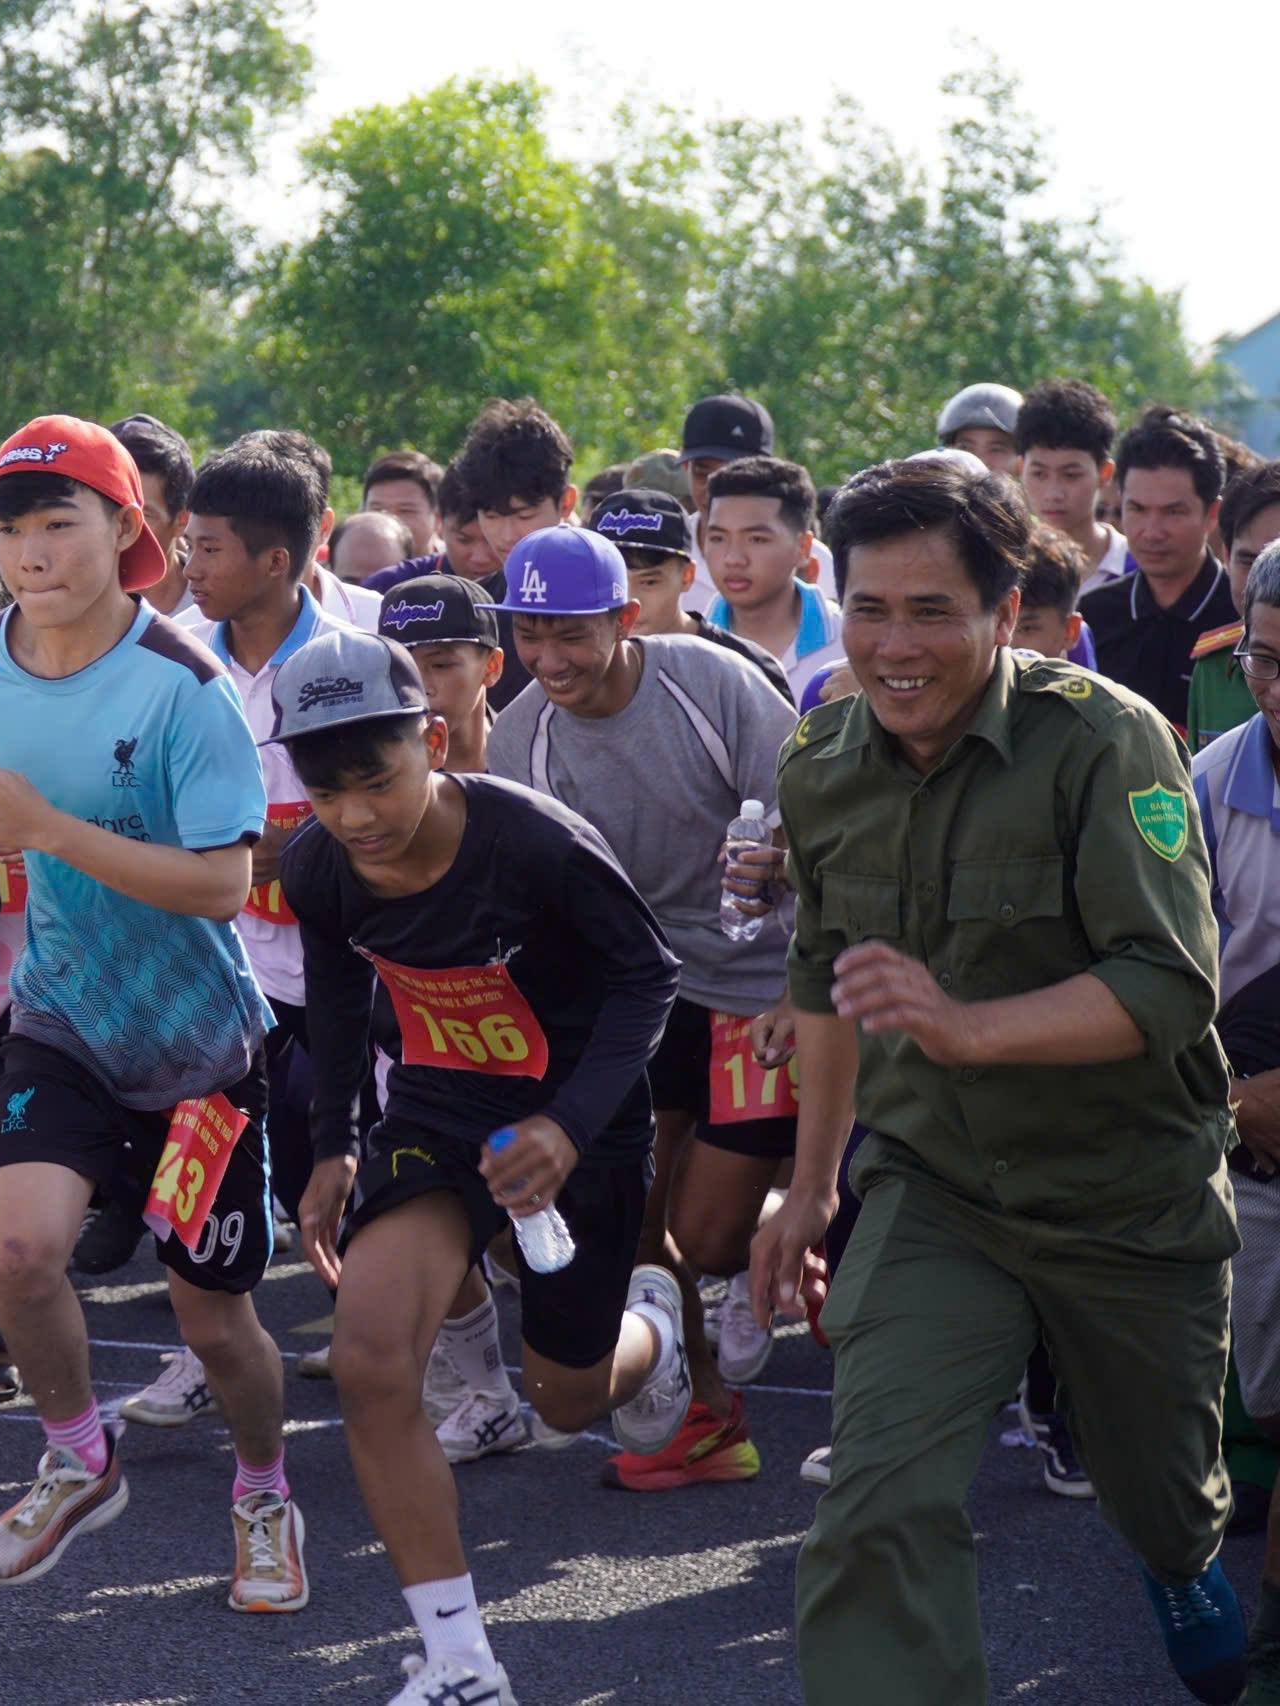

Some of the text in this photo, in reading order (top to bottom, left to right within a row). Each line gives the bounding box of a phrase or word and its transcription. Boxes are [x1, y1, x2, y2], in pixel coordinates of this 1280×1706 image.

[519, 561, 547, 603] LA
[411, 1004, 529, 1064] 166
[187, 1211, 246, 1267] 09
